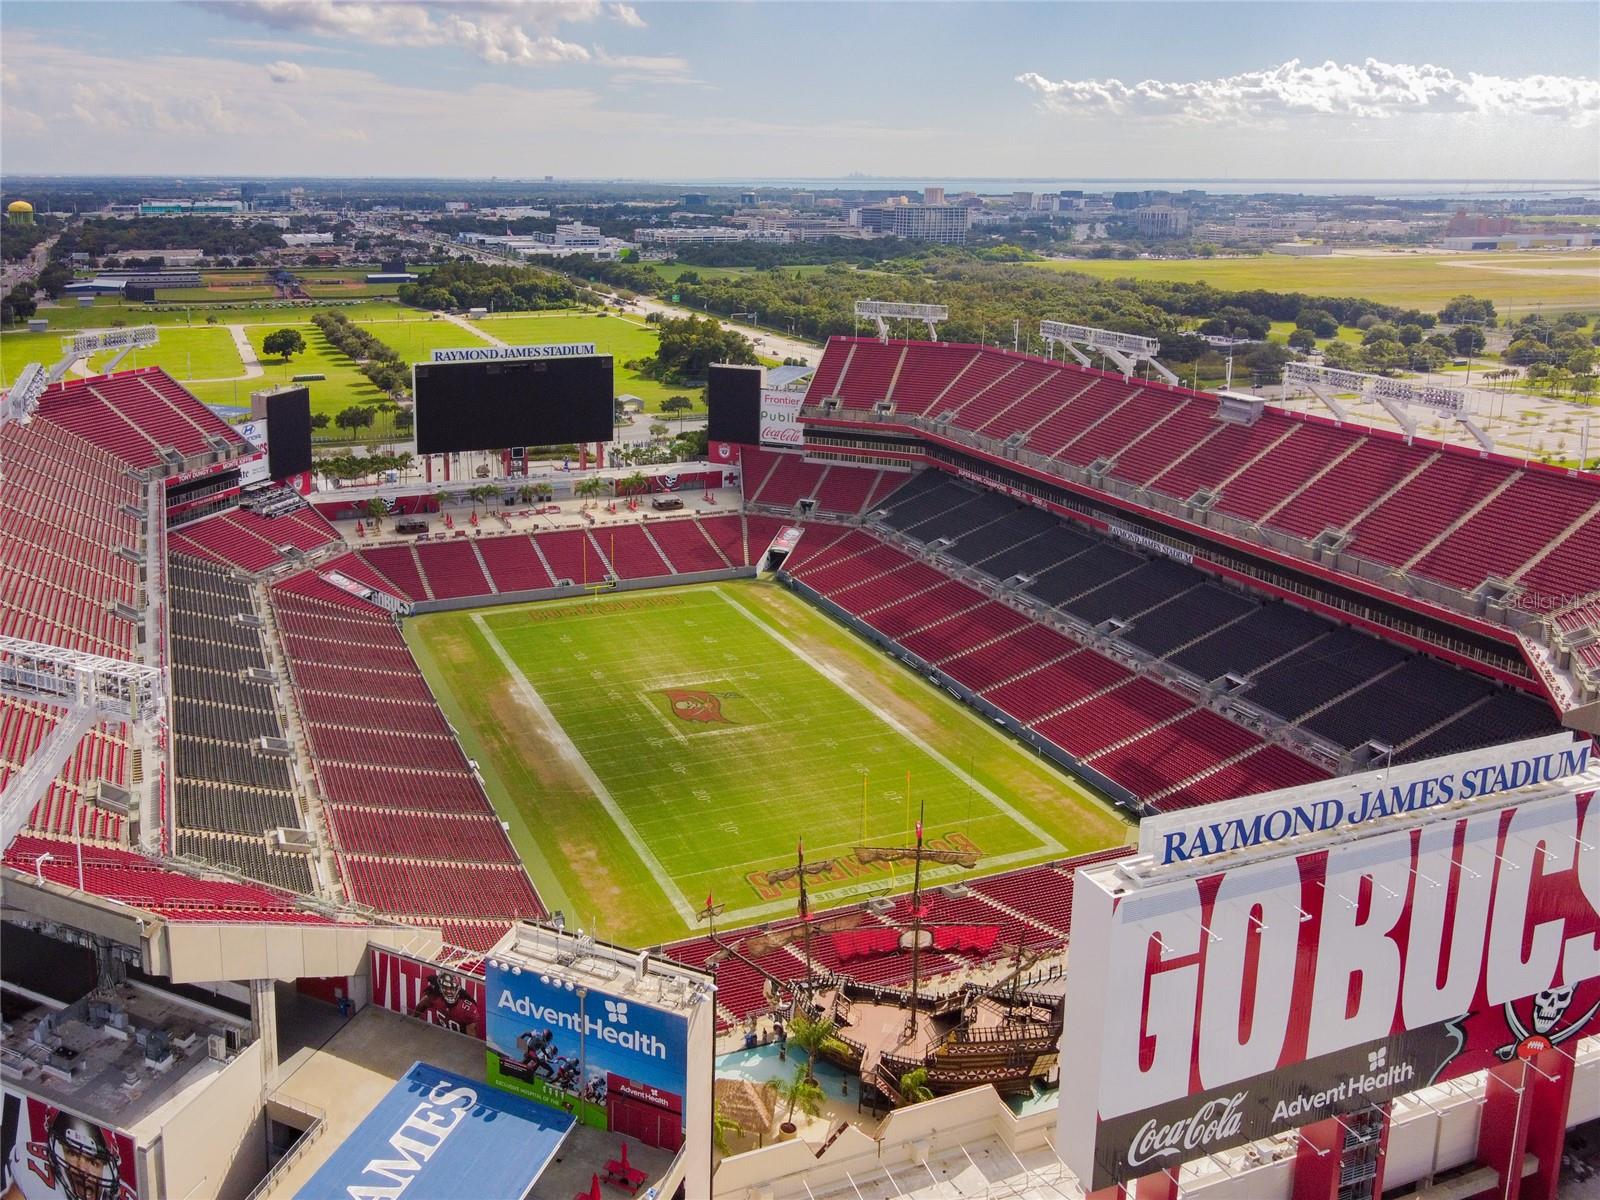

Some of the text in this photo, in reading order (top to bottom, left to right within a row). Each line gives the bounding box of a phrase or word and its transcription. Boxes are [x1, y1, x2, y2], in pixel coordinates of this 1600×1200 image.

[434, 344, 594, 362] RAYMOND JAMES STADIUM
[761, 411, 795, 423] Publi
[764, 394, 800, 406] Frontier
[1140, 537, 1161, 550] JAMES
[1162, 546, 1192, 562] STADIUM
[1161, 746, 1590, 866] RAYMOND JAMES STADIUM
[1100, 857, 1303, 1121] GO
[498, 989, 667, 1060] AdventHealth
[1271, 1060, 1415, 1123] AdventHealth
